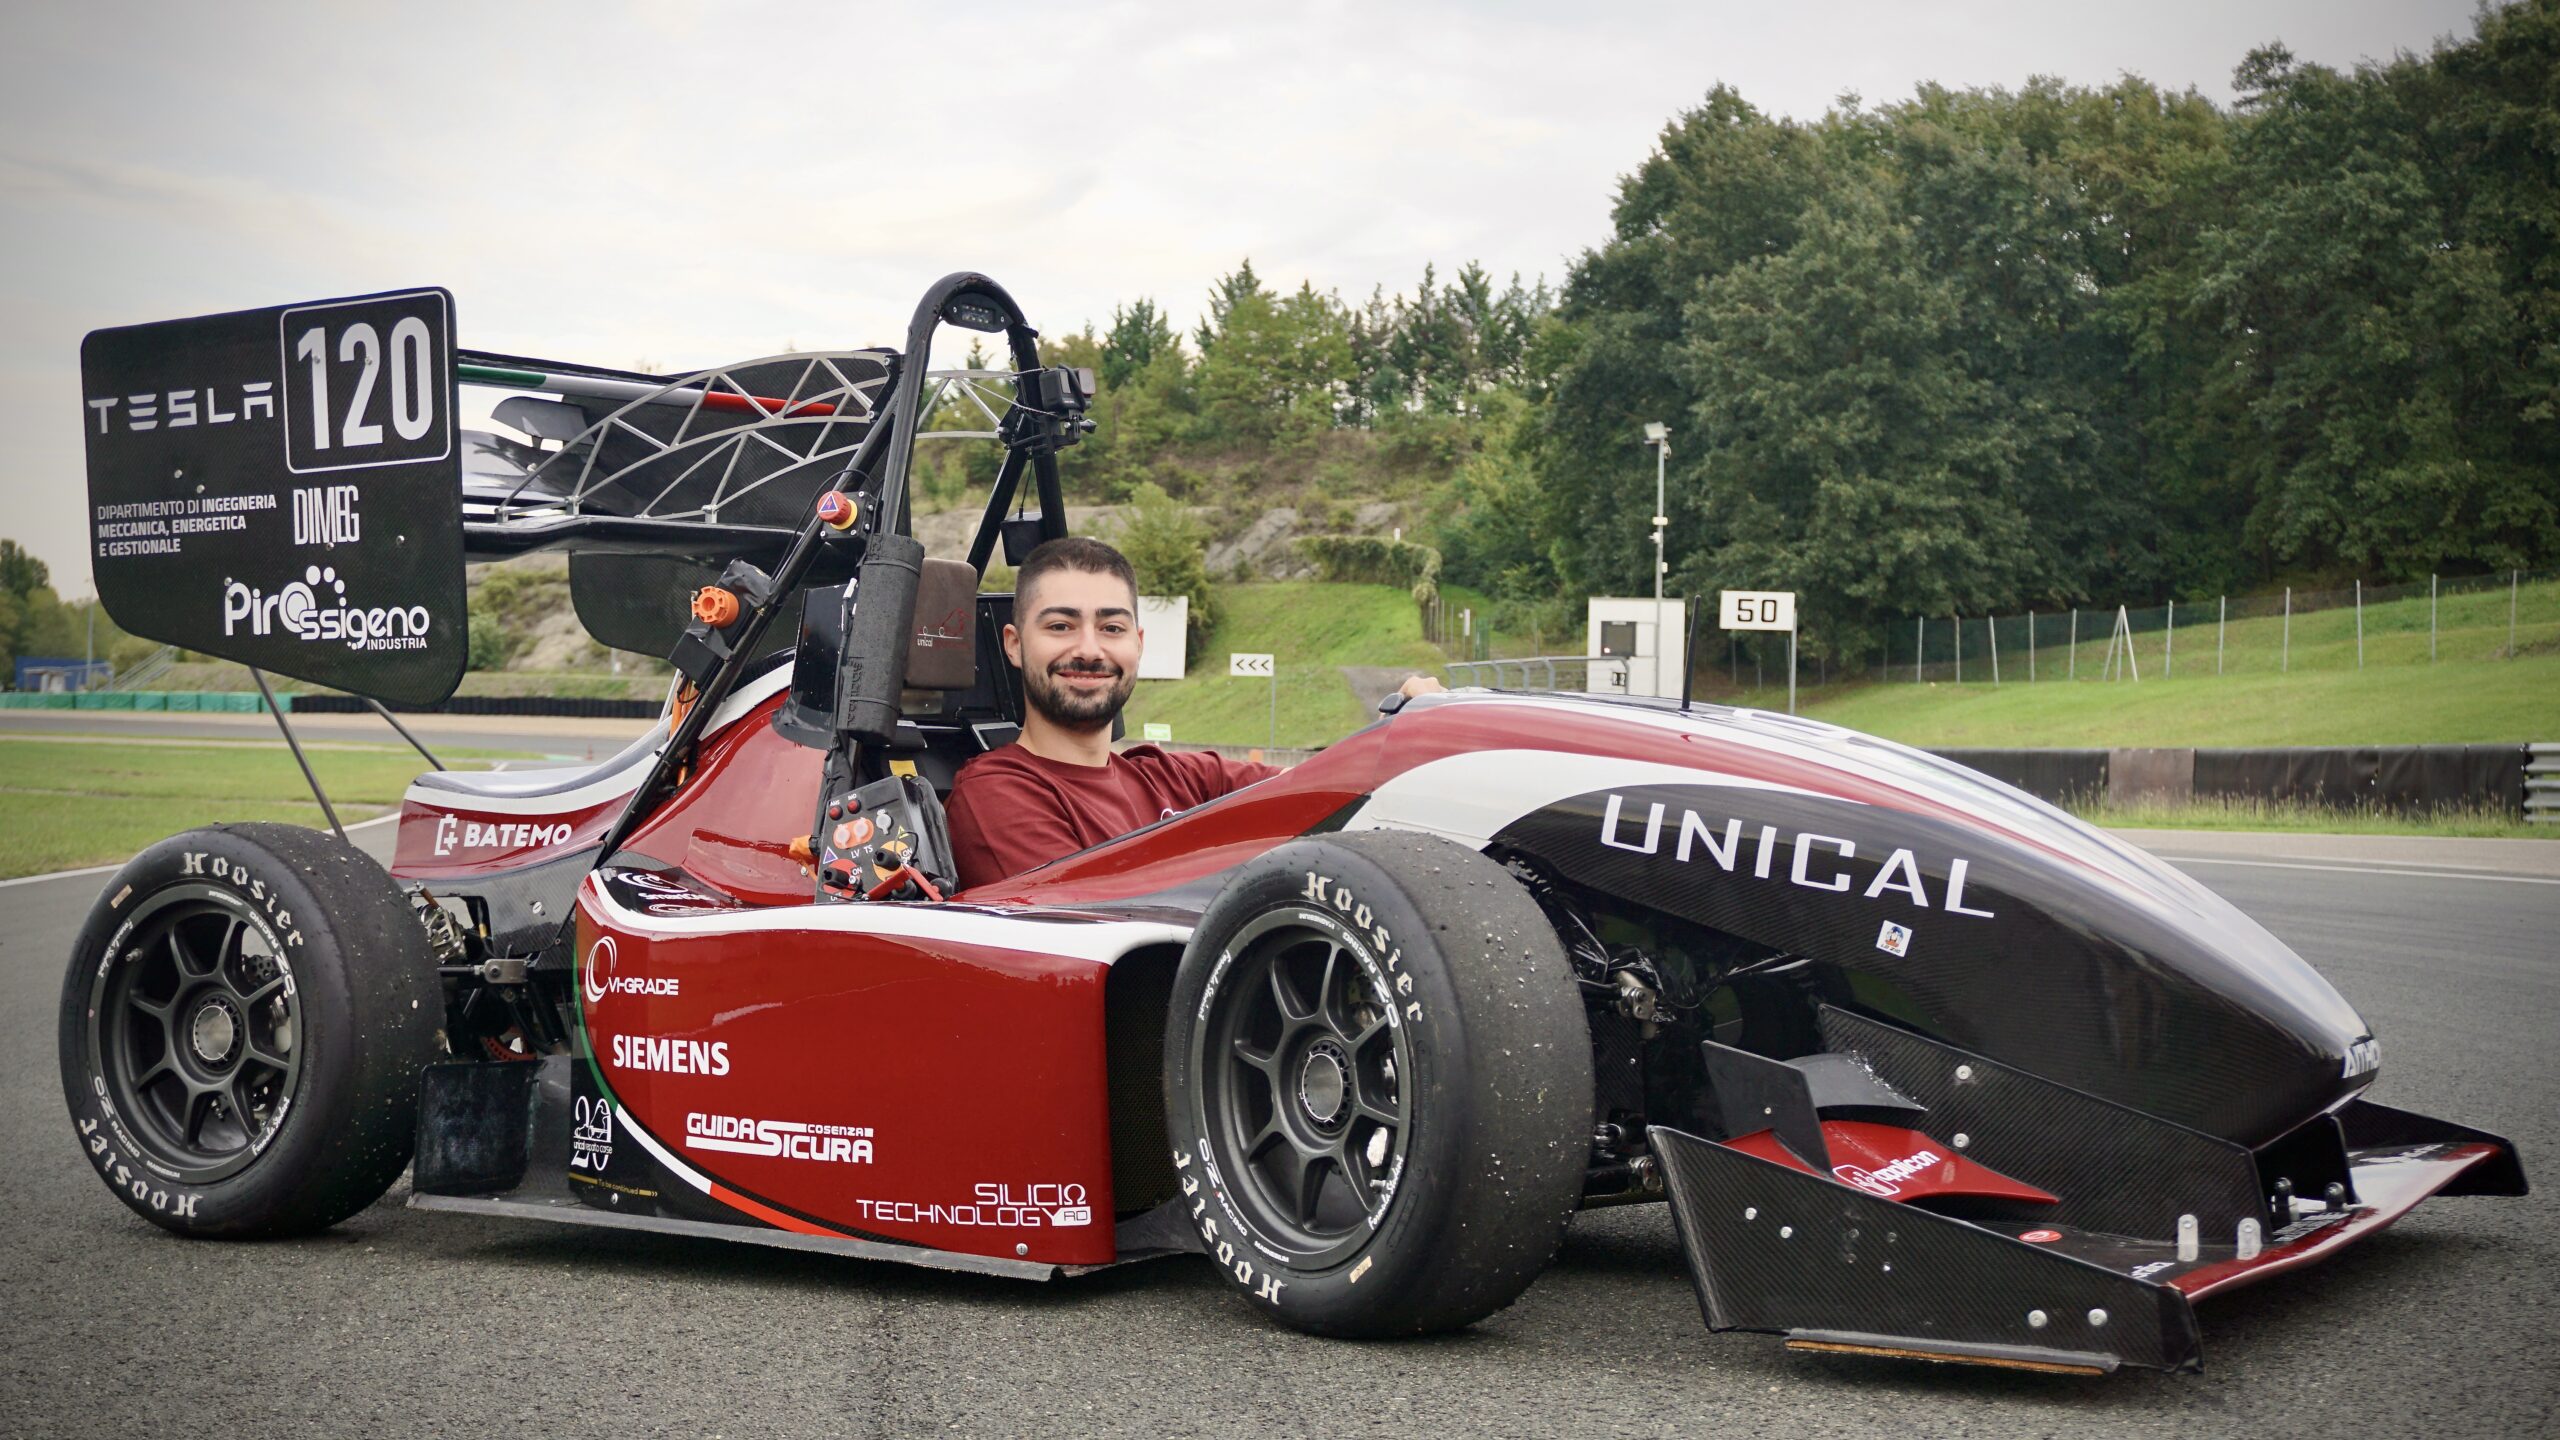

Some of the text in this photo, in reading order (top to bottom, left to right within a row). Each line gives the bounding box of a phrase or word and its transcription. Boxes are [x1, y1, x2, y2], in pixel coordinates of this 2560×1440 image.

[297, 316, 434, 450] 120
[88, 381, 274, 434] TESLA
[97, 494, 277, 521] DIPARTIMENTO DI INGEGNERIA
[293, 485, 360, 545] DIMEG
[98, 515, 247, 539] MECCANICA, ENERGETICA
[98, 538, 182, 557] E GESTIONALE
[1737, 598, 1777, 623] 50
[367, 638, 428, 650] INDUSTRIA
[463, 823, 572, 847] BATEMO
[850, 844, 874, 859] LV TS
[902, 848, 913, 858] ON
[852, 866, 863, 876] ON
[1600, 794, 1995, 918] UNICAL
[179, 852, 304, 947] Hoosier
[249, 911, 279, 949] RACING
[1301, 871, 1423, 1022] Hoosier
[1342, 932, 1377, 974] RACING
[607, 976, 679, 996] VI-GRADE
[612, 1033, 730, 1076] SIEMENS
[111, 1120, 141, 1158] RACING
[80, 1118, 203, 1218] Hoosier
[1872, 1150, 1941, 1182] applicon
[856, 1199, 1056, 1227] TECHNOLOGY
[1173, 1150, 1288, 1305] Hoosier
[1217, 1191, 1247, 1237] RACING
